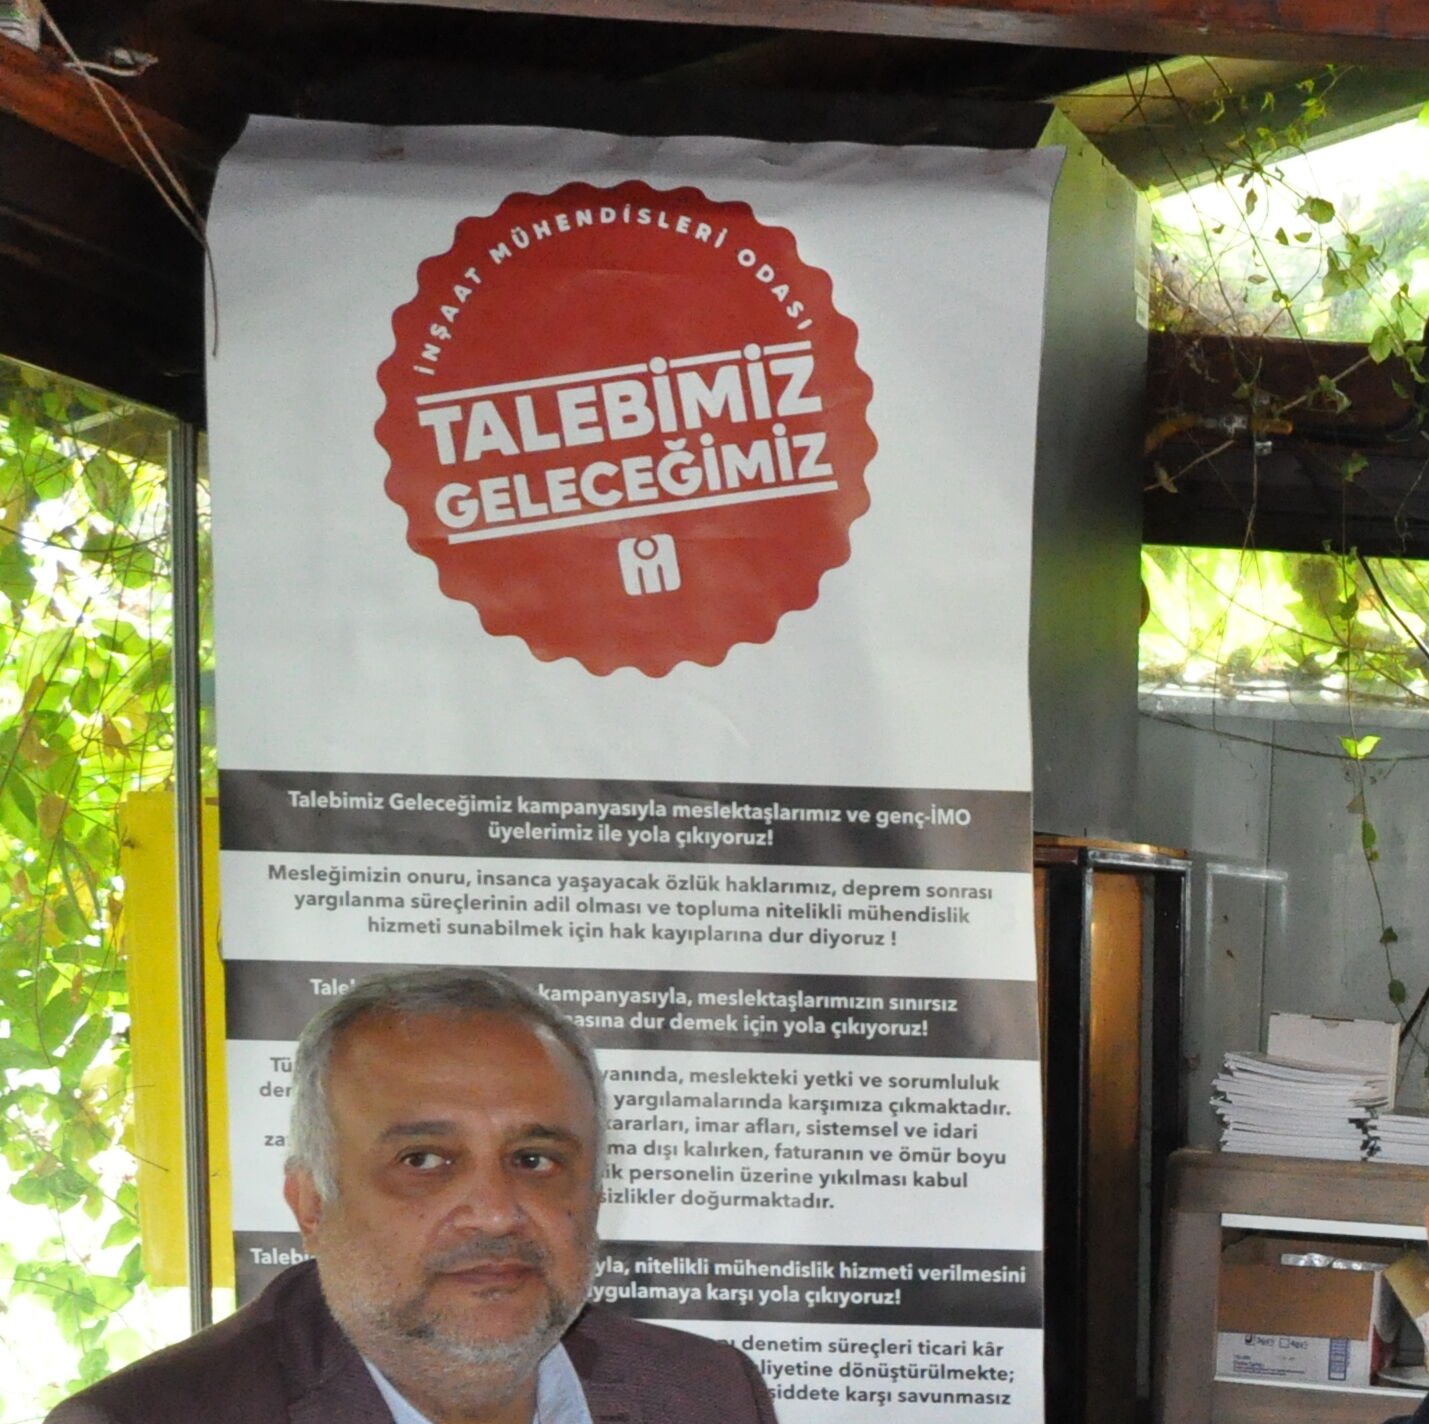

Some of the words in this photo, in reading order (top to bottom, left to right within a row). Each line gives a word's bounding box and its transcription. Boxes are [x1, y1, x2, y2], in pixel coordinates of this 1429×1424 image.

[413, 267, 482, 375] İNŞAAT
[489, 203, 728, 264] MÜHENDİSLERİ
[738, 248, 813, 329] ODASI
[416, 343, 824, 466] TALEBİMİZ
[434, 422, 834, 530] GELECEĞİMİZ
[288, 790, 384, 809] Talebimiz
[389, 793, 512, 817] Geleceğimiz
[517, 795, 667, 821] kampanyasıyla
[672, 801, 841, 824] meslektaşlarımız
[846, 810, 871, 823] ve
[876, 803, 971, 829] genç-İMO
[488, 821, 593, 843] üyelerimiz
[598, 824, 622, 842] ile
[627, 825, 670, 847] yola
[675, 826, 773, 849] çıkıyoruz!
[268, 864, 401, 886] Mesleğimizin
[407, 872, 471, 887] onuru,
[477, 869, 551, 887] insanca
[557, 873, 660, 893] yaşayacak
[665, 874, 720, 891] özlük
[726, 876, 836, 897] haklarımız,
[842, 879, 920, 901] deprem
[926, 886, 992, 899] sonrası
[294, 890, 405, 911] yargılanma
[411, 893, 527, 915] süreçlerinin
[533, 895, 570, 912] adil
[576, 896, 641, 914] olması
[647, 903, 671, 915] ve
[676, 900, 760, 921] topluma
[766, 902, 841, 920] nitelikli
[848, 904, 969, 923] mühendislik
[368, 916, 441, 934] hizmeti
[447, 919, 563, 937] sunabilmek
[569, 921, 604, 942] için
[610, 922, 646, 939] hak
[652, 923, 763, 946] kayıplarına
[769, 926, 804, 943] dur
[809, 928, 885, 949] diyoruz
[538, 983, 692, 1008] kampanyasıyla,
[698, 988, 884, 1012] meslektaşlarımızın
[889, 998, 958, 1012] sınırsız
[629, 1011, 665, 1029] dur
[670, 1012, 738, 1031] demek
[743, 1014, 778, 1037] için
[783, 1016, 826, 1038] yola
[831, 1017, 928, 1040] çıkıyoruz!
[690, 1068, 798, 1085] meslekteki
[804, 1070, 853, 1090] yetki
[859, 1076, 883, 1088] ve
[888, 1073, 999, 1091] sorumluluk
[613, 1090, 782, 1111] yargılamalarında
[789, 1094, 883, 1115] karşımıza
[888, 1097, 1011, 1117] çıkmaktadır.
[695, 1116, 740, 1133] imar
[745, 1117, 800, 1137] afları,
[806, 1119, 898, 1137] sistemsel
[904, 1126, 928, 1138] ve
[933, 1122, 977, 1139] idari
[643, 1139, 678, 1160] dışı
[684, 1140, 769, 1161] kalırken,
[774, 1142, 864, 1161] faturanın
[869, 1150, 893, 1162] ve
[899, 1146, 951, 1163] ömür
[957, 1147, 1006, 1169] boyu
[629, 1165, 734, 1184] personelin
[740, 1166, 813, 1184] üzerine
[819, 1169, 907, 1189] yıkılması
[913, 1171, 968, 1188] kabul
[681, 1189, 834, 1211] doğurmaktadır.
[635, 1257, 709, 1275] nitelikli
[714, 1259, 834, 1278] mühendislik
[839, 1261, 913, 1280] hizmeti
[918, 1264, 1026, 1283] verilmesini
[706, 1283, 754, 1306] karşı
[758, 1285, 800, 1306] yola
[804, 1286, 900, 1308] çıkıyoruz!
[741, 1334, 822, 1353] denetim
[828, 1338, 912, 1359] süreçleri
[917, 1339, 966, 1356] ticari
[973, 1340, 1004, 1357] kâr
[839, 1361, 1014, 1383] dönüştürülmekte;
[846, 1385, 892, 1407] karşı
[898, 1391, 1011, 1405] savunmasız
